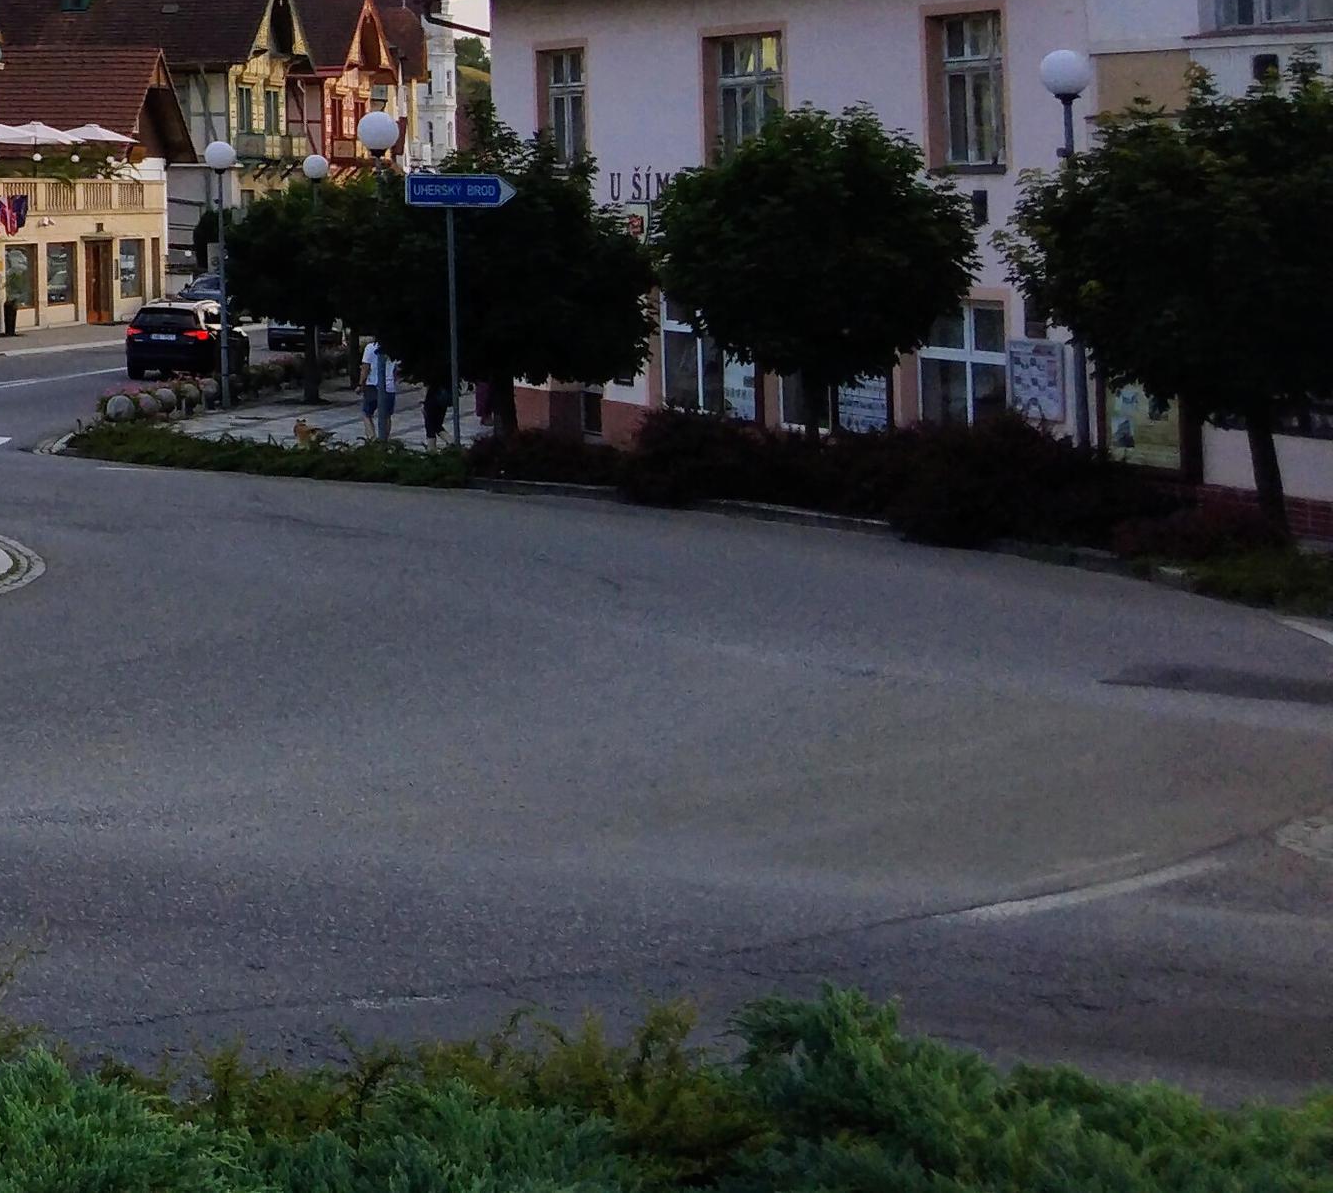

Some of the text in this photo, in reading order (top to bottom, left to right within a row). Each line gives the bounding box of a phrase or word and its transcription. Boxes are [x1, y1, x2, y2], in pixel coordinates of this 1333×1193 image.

[466, 184, 496, 197] BROD
[609, 165, 671, 202] U ŠÍM
